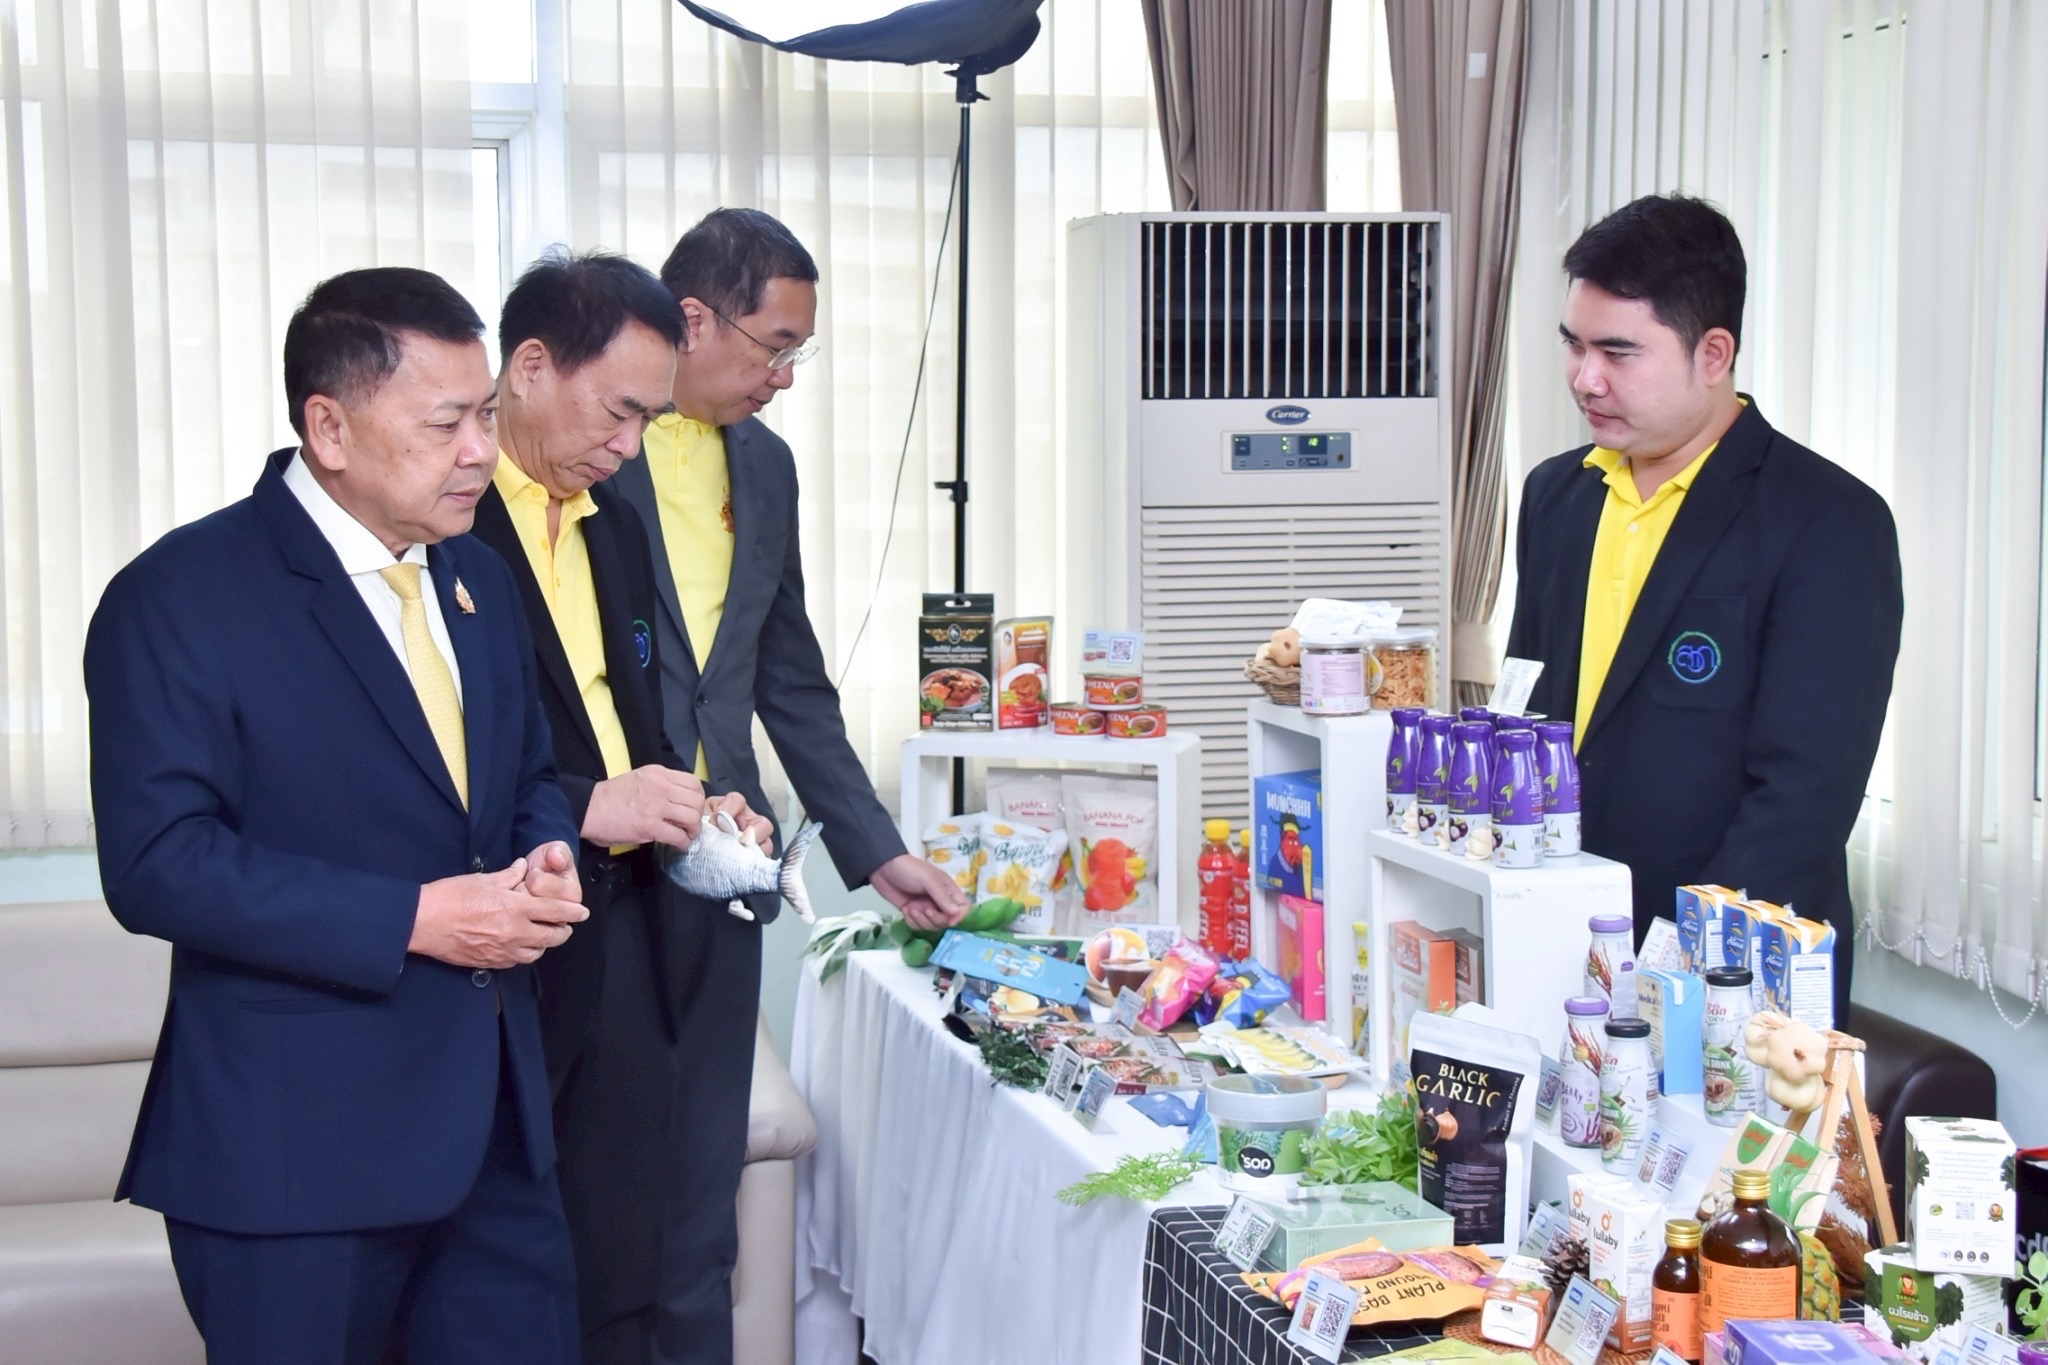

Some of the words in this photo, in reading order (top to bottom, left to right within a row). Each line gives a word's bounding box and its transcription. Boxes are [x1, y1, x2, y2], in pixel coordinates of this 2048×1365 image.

[1271, 409, 1305, 419] Carrier
[1438, 1063, 1490, 1087] BLACK
[1416, 1074, 1501, 1108] GARLIC
[1593, 1227, 1619, 1250] lullaby
[1399, 1280, 1446, 1301] PLANT
